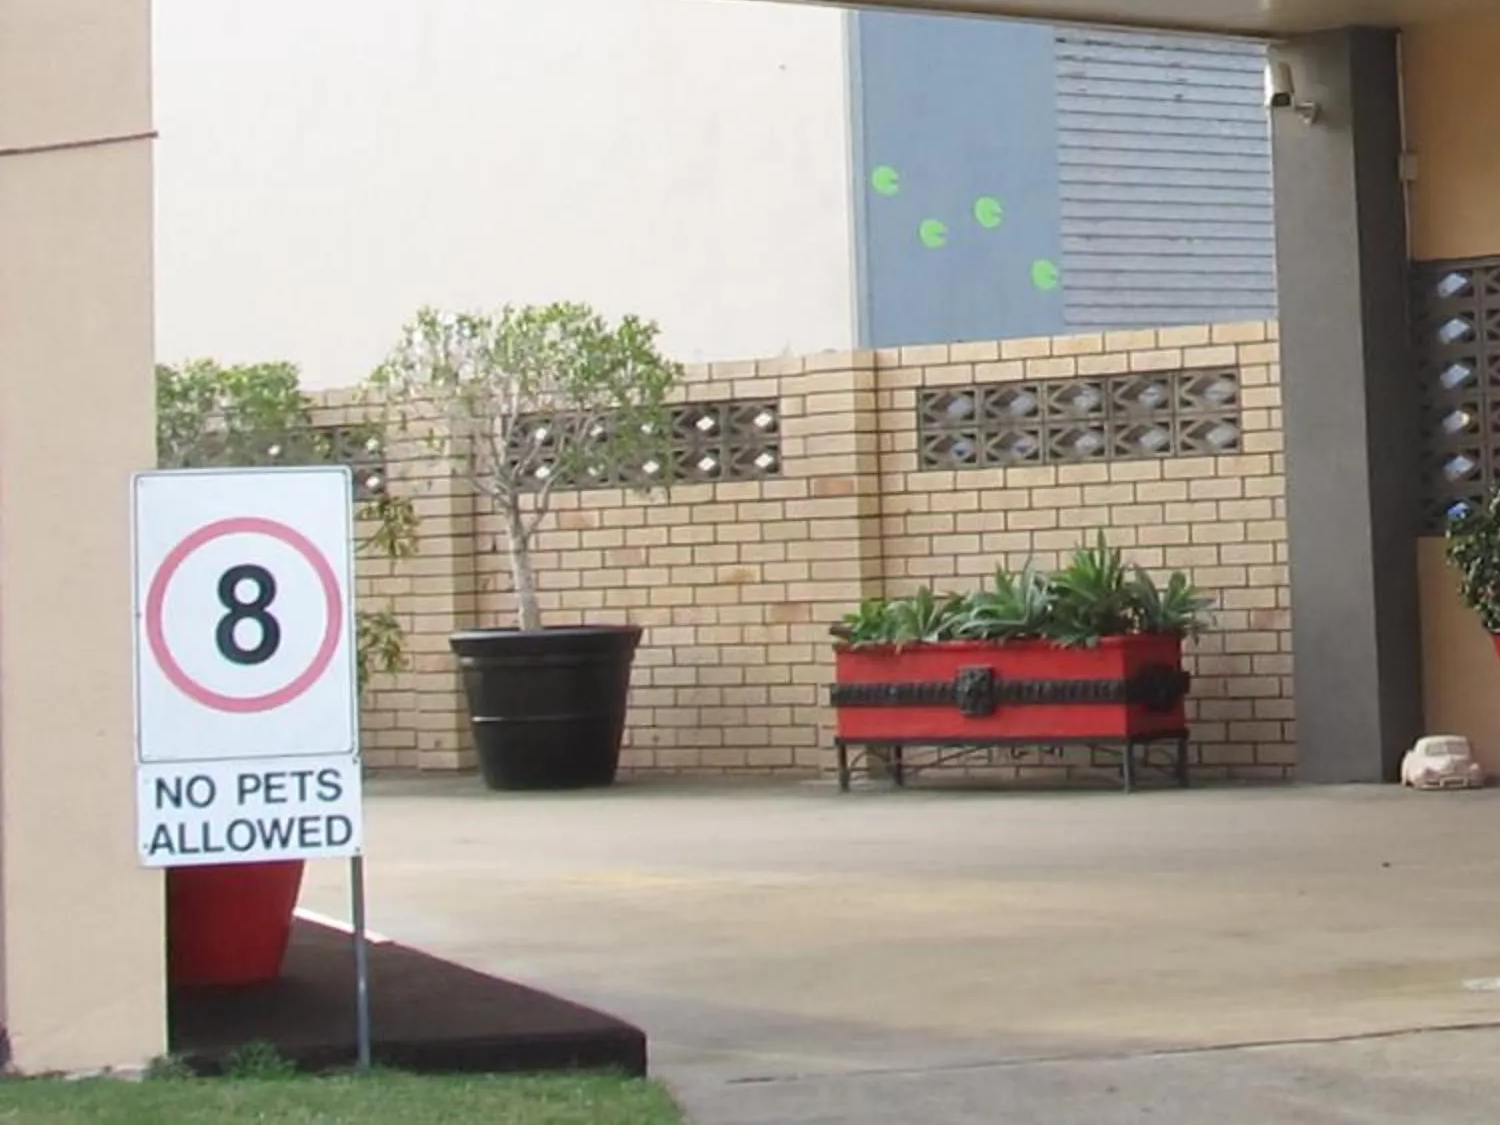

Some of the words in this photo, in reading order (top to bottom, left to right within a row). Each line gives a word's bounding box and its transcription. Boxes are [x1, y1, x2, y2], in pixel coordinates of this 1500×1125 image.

[214, 563, 282, 666] 8
[154, 774, 217, 810] NO
[236, 768, 343, 806] PETS
[148, 814, 353, 856] ALLOWED
